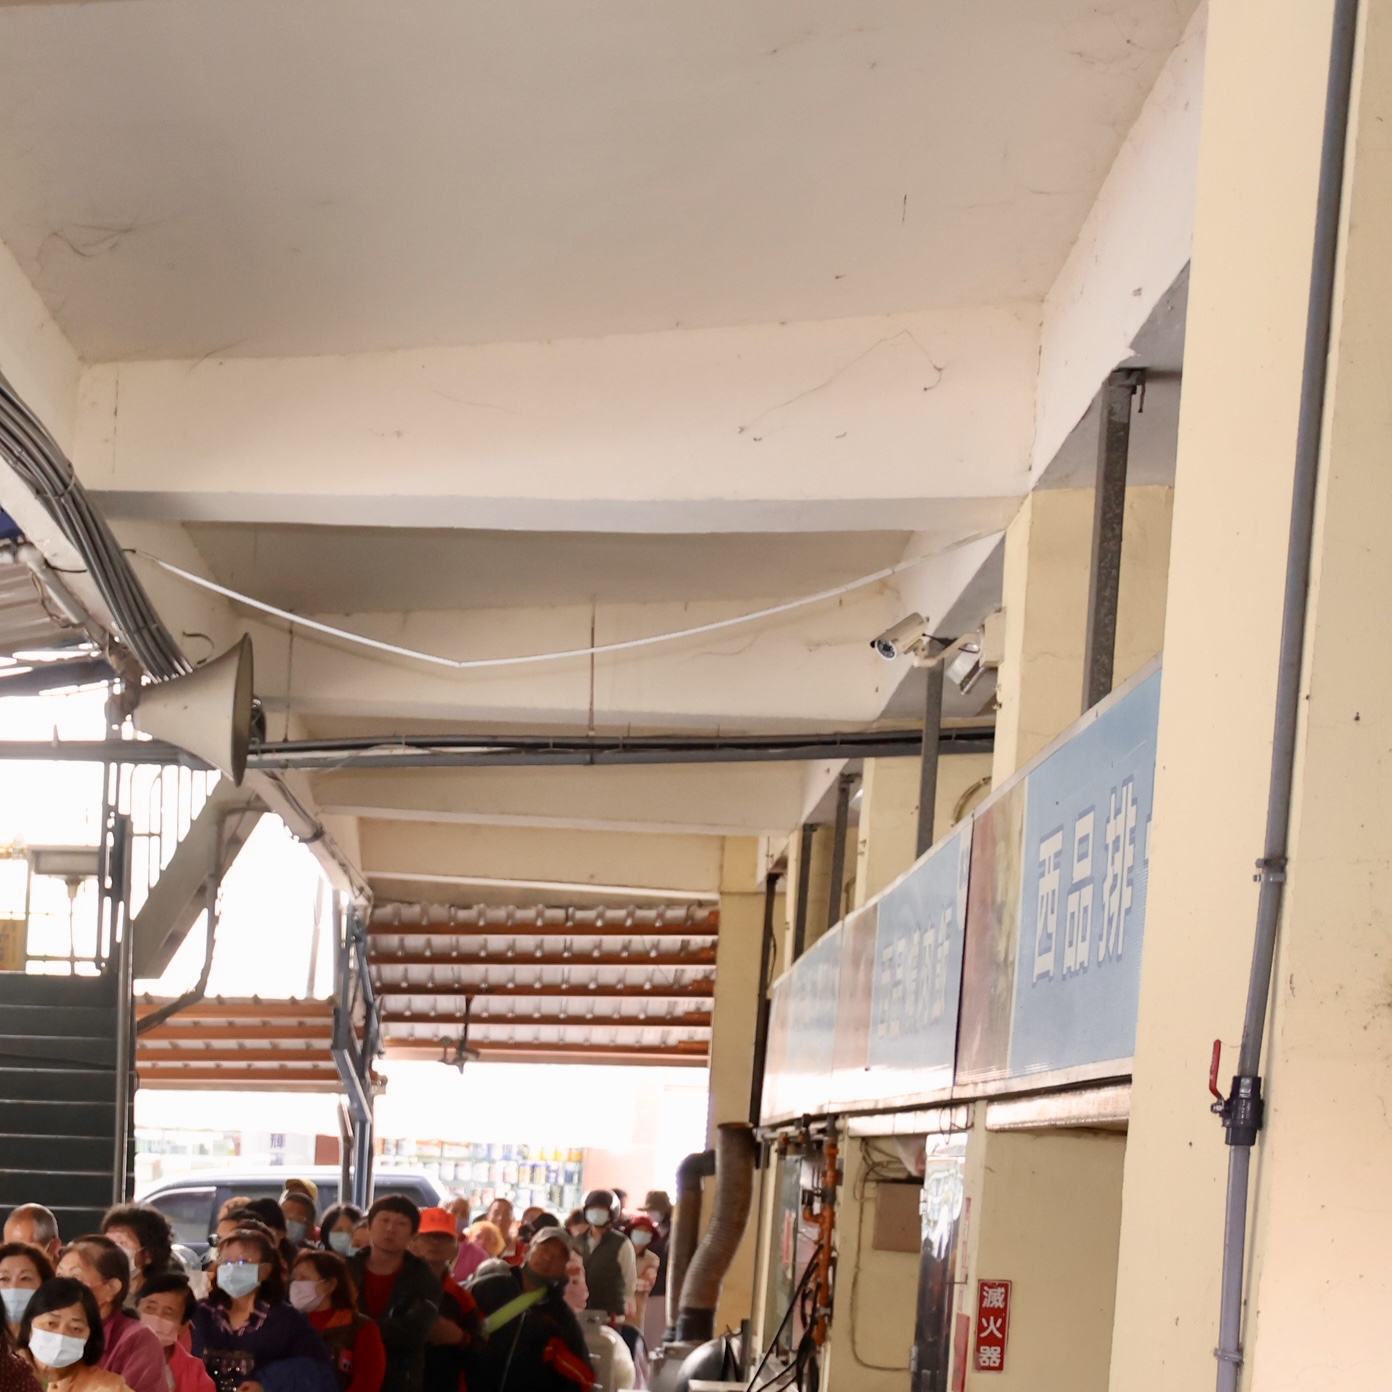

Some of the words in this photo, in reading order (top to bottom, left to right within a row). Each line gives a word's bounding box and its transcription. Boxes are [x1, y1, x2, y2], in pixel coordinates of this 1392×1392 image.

[1032, 777, 1151, 984] 西品排
[978, 1286, 1005, 1367] 滅火器
